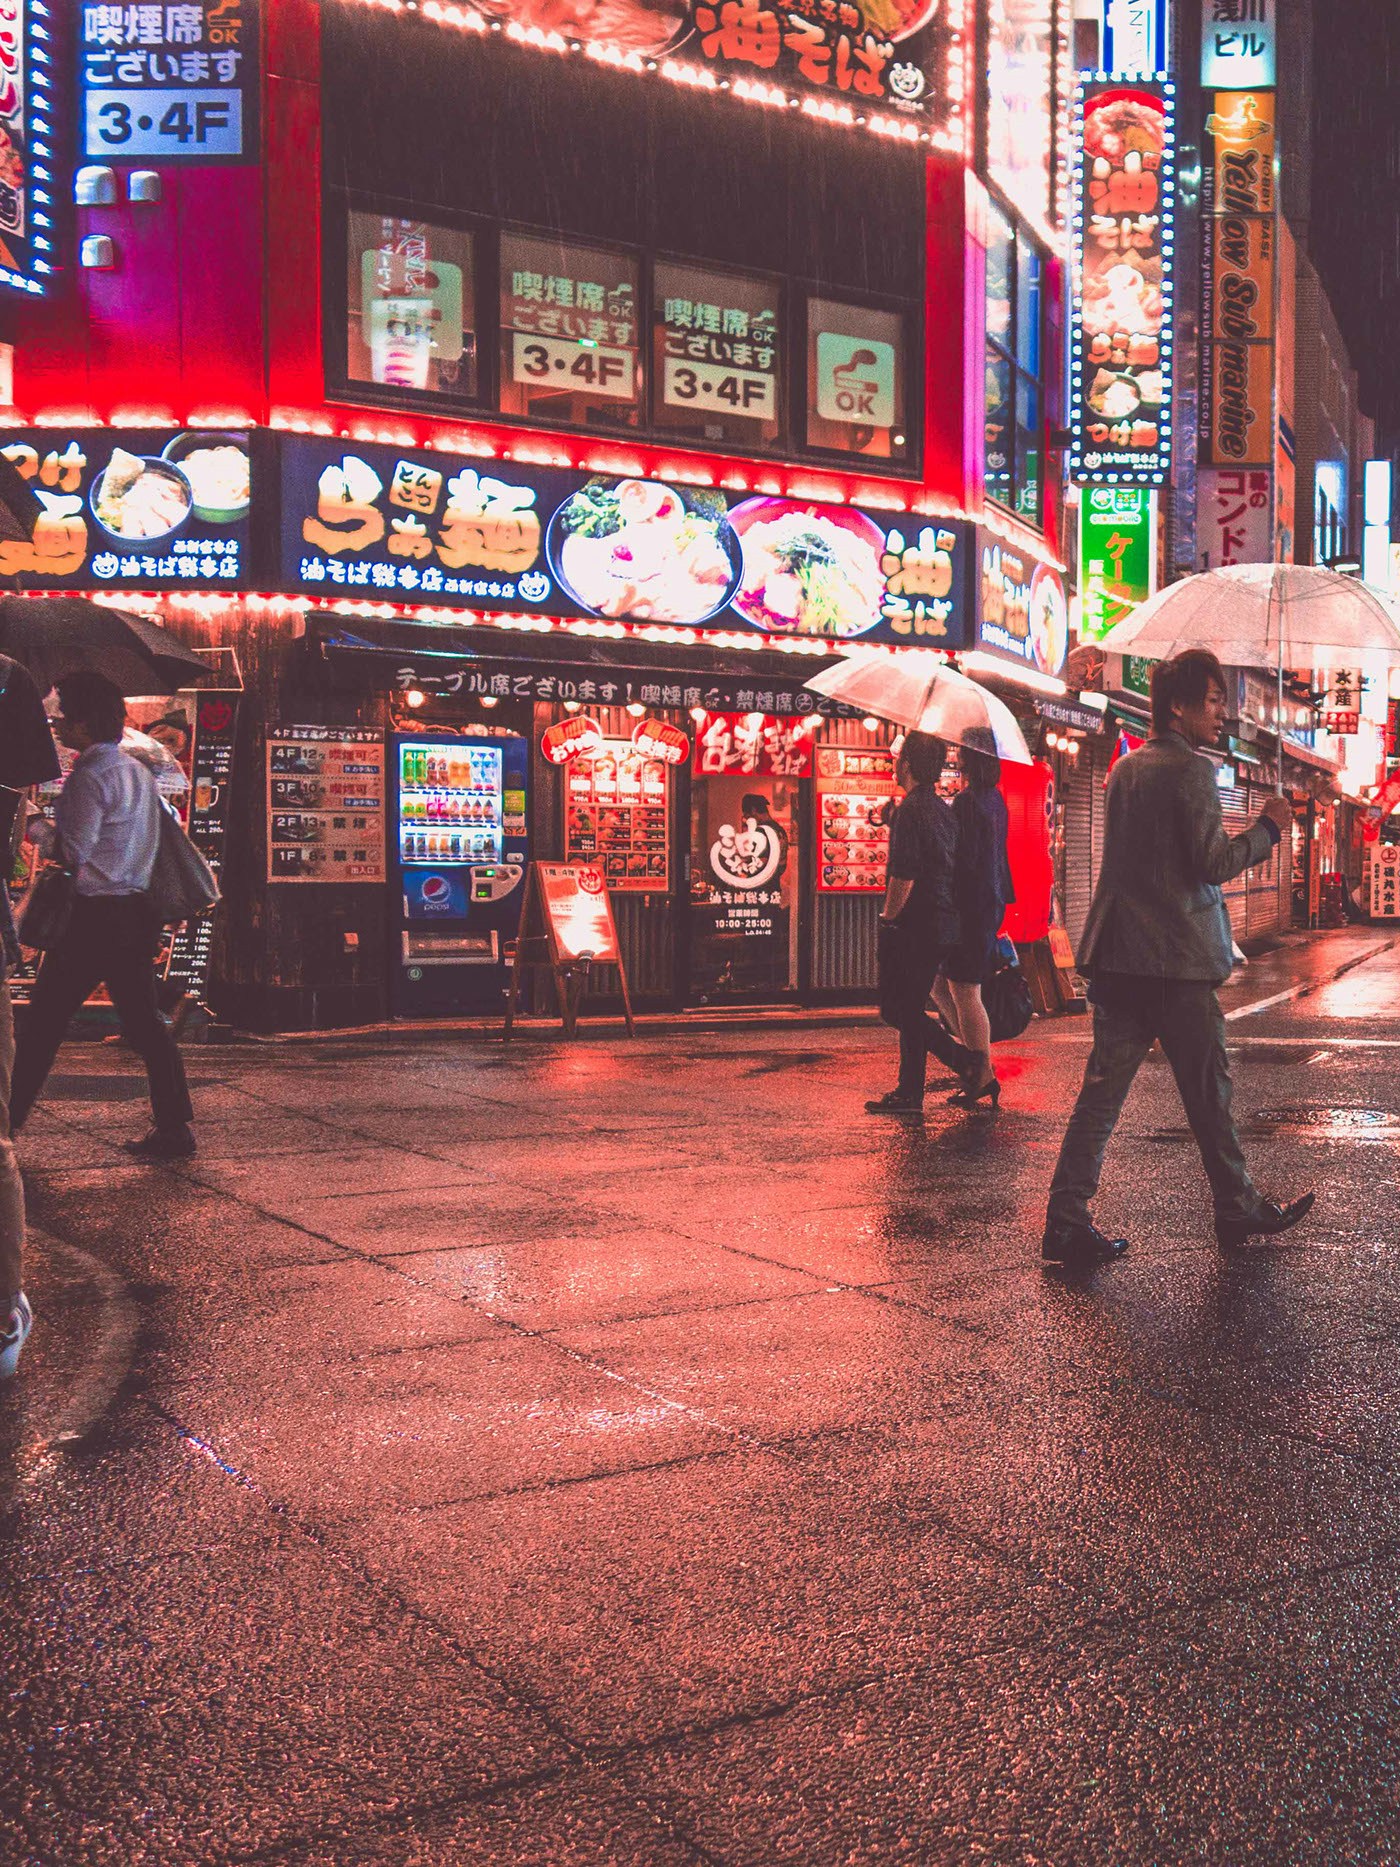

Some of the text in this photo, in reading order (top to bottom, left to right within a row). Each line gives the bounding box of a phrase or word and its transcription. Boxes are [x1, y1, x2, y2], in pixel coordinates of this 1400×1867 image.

[84, 3, 203, 44] 喫煙席
[210, 31, 239, 43] OK
[1215, 31, 1265, 57] ビル
[84, 50, 242, 83] ございます
[1261, 154, 1270, 206] HOBBY
[513, 270, 605, 312] 喫煙席
[513, 305, 633, 344] ございます
[664, 298, 749, 338] 喫煙席
[664, 331, 774, 369] ございます
[753, 330, 773, 342] OK
[835, 390, 875, 415] OK
[1217, 472, 1248, 565] コンド
[1335, 668, 1352, 706] 水産
[276, 749, 297, 758] 4F
[276, 783, 297, 793] 3F
[276, 817, 297, 827] 2F
[279, 851, 297, 861] 1F
